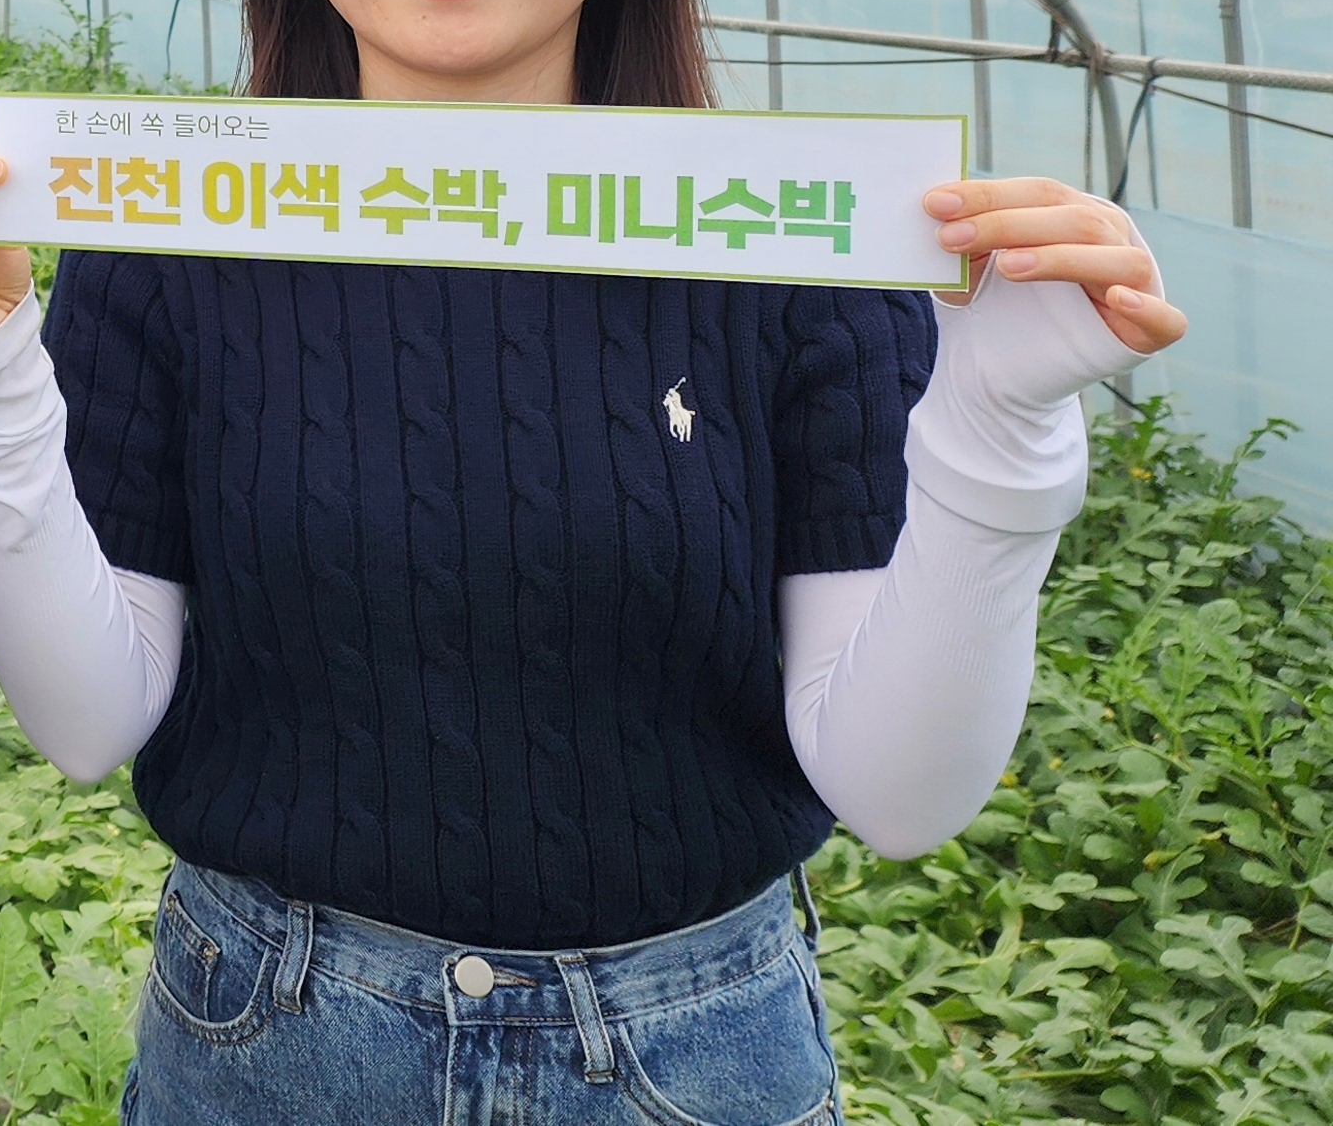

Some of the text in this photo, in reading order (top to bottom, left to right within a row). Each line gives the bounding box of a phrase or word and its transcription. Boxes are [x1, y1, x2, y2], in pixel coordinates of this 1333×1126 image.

[56, 110, 270, 139] 한 손에 쏙 들어오는
[48, 156, 856, 254] 진천 이색 수박, 미니수박
